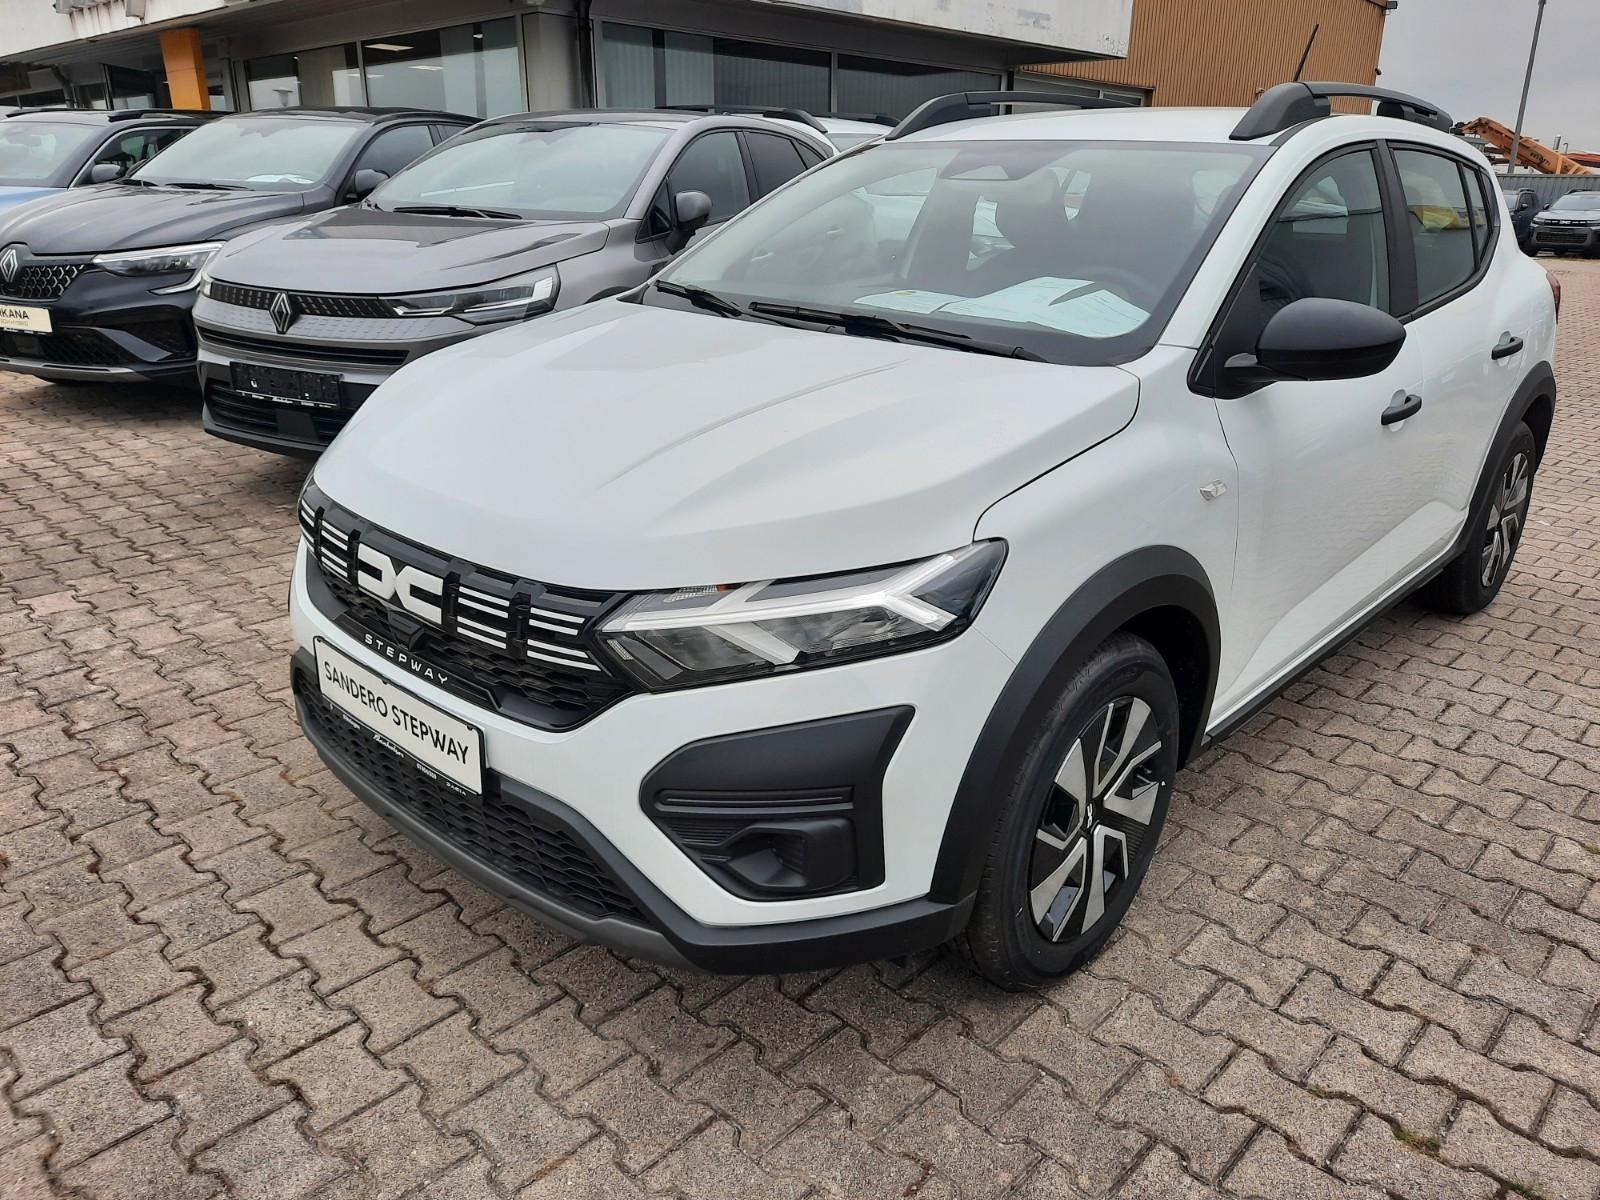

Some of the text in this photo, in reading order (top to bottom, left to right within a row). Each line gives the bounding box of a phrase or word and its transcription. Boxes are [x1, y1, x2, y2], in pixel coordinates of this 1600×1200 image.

[364, 633, 449, 684] STEPWAY
[324, 661, 388, 718] SANDERO
[391, 704, 469, 765] STEPWAY
